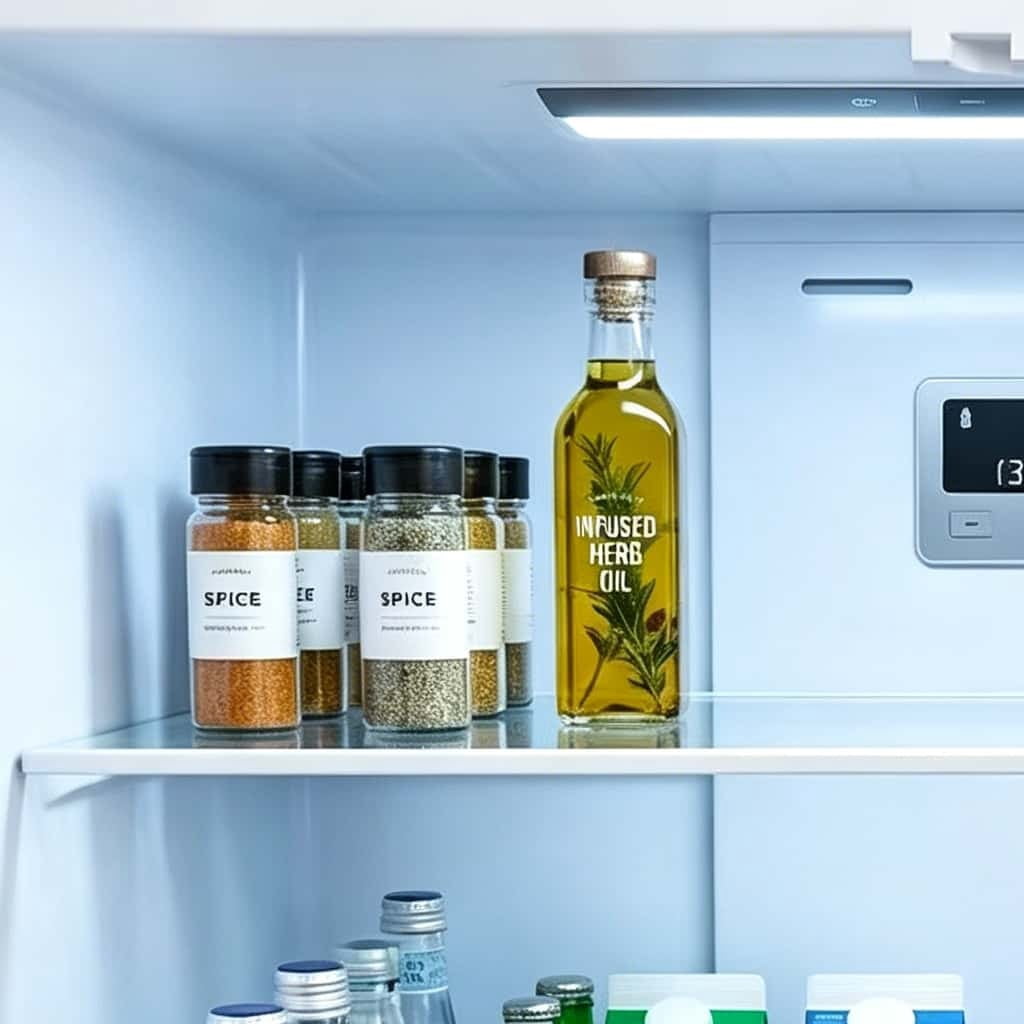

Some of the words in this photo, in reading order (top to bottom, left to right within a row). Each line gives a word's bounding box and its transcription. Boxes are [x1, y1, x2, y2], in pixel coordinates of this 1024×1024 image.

[589, 541, 643, 565] HERB
[600, 570, 632, 593] OIL
[204, 592, 262, 607] SPICE
[380, 592, 437, 607] SPICE
